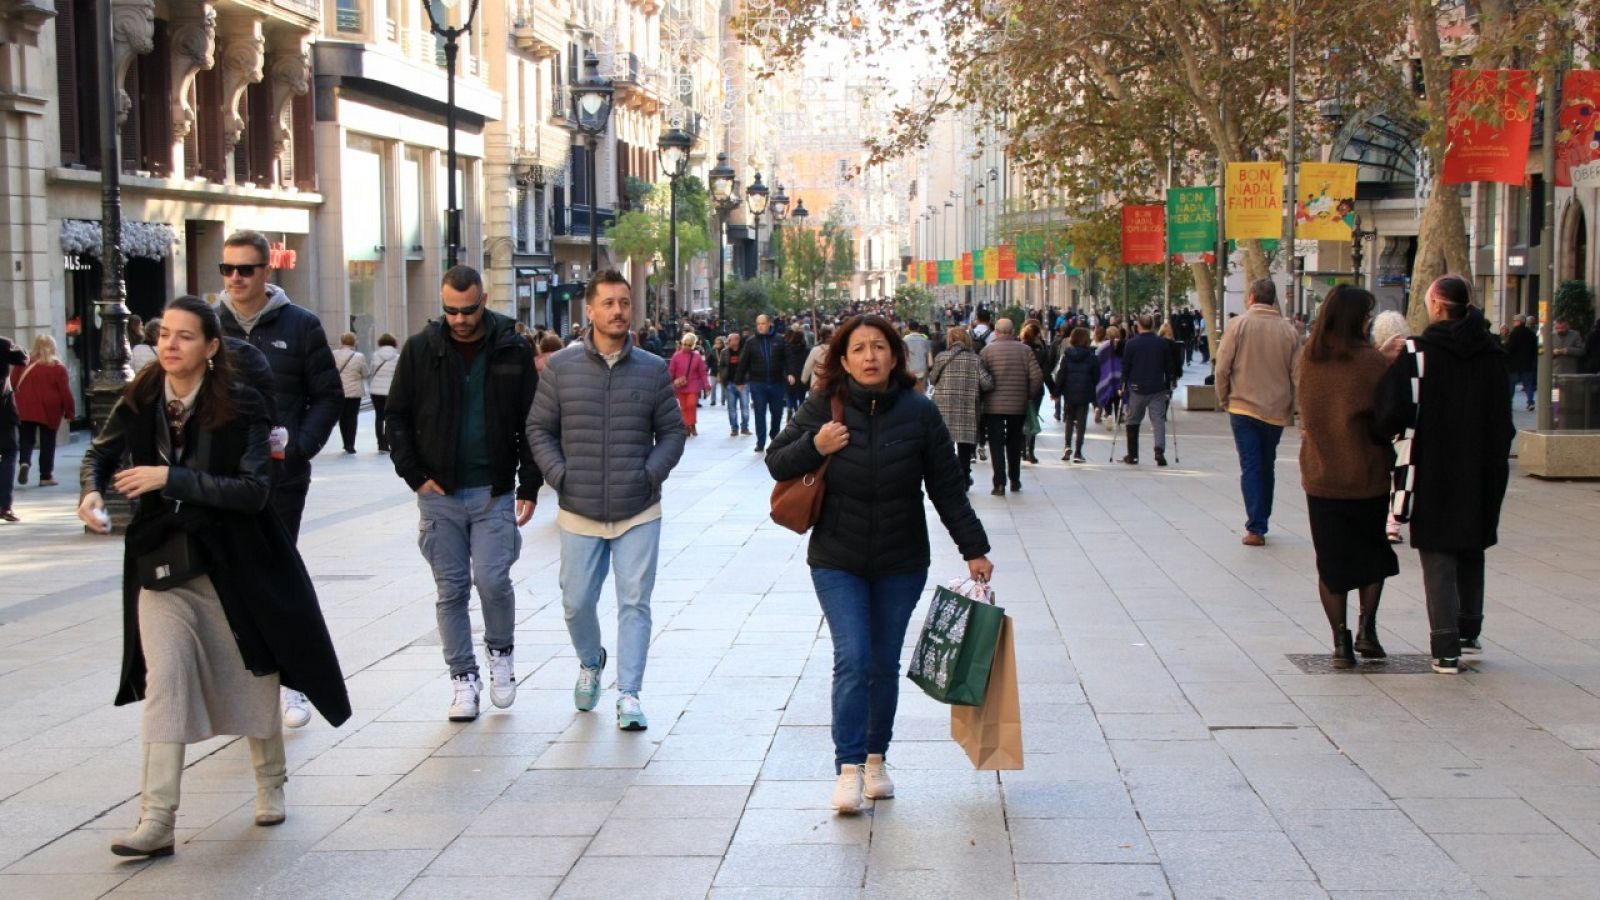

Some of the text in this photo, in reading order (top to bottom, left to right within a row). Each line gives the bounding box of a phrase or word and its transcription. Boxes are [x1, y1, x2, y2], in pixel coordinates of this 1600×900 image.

[1239, 168, 1270, 182] BON
[1233, 183, 1275, 196] NADAL
[1179, 192, 1204, 203] BON
